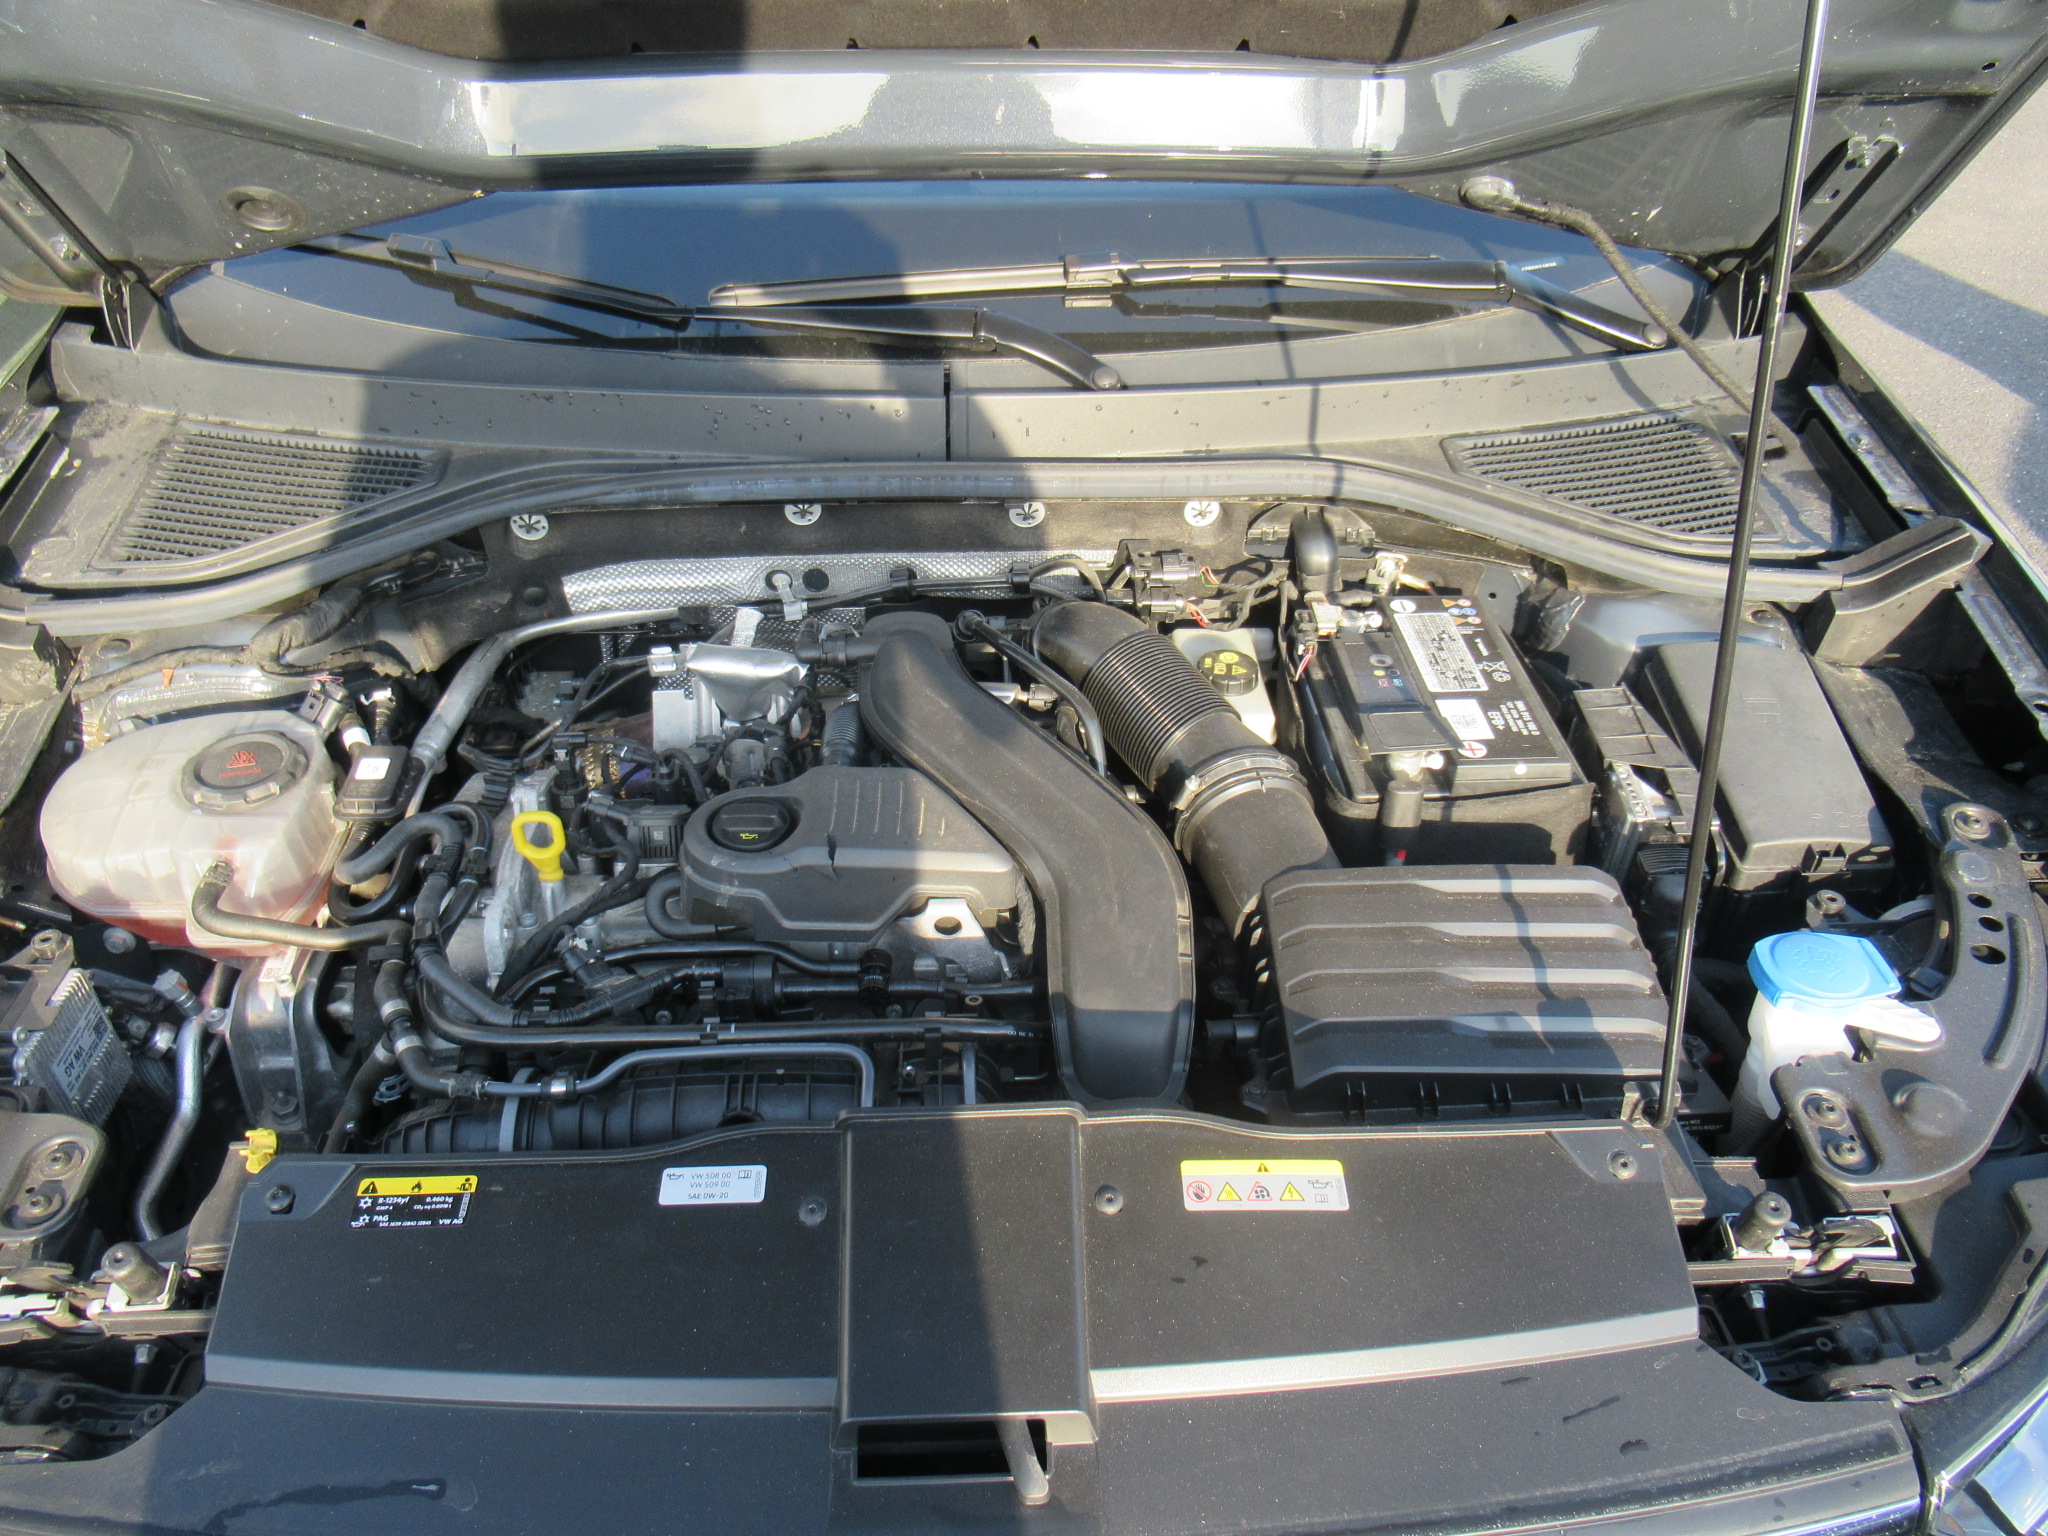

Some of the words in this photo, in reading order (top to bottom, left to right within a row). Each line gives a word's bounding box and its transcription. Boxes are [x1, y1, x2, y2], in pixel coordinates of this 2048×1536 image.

[1487, 711, 1506, 730] EFB+
[378, 1196, 410, 1205] R-1234yf
[445, 1195, 454, 1203] kg
[373, 1214, 389, 1222] PAG
